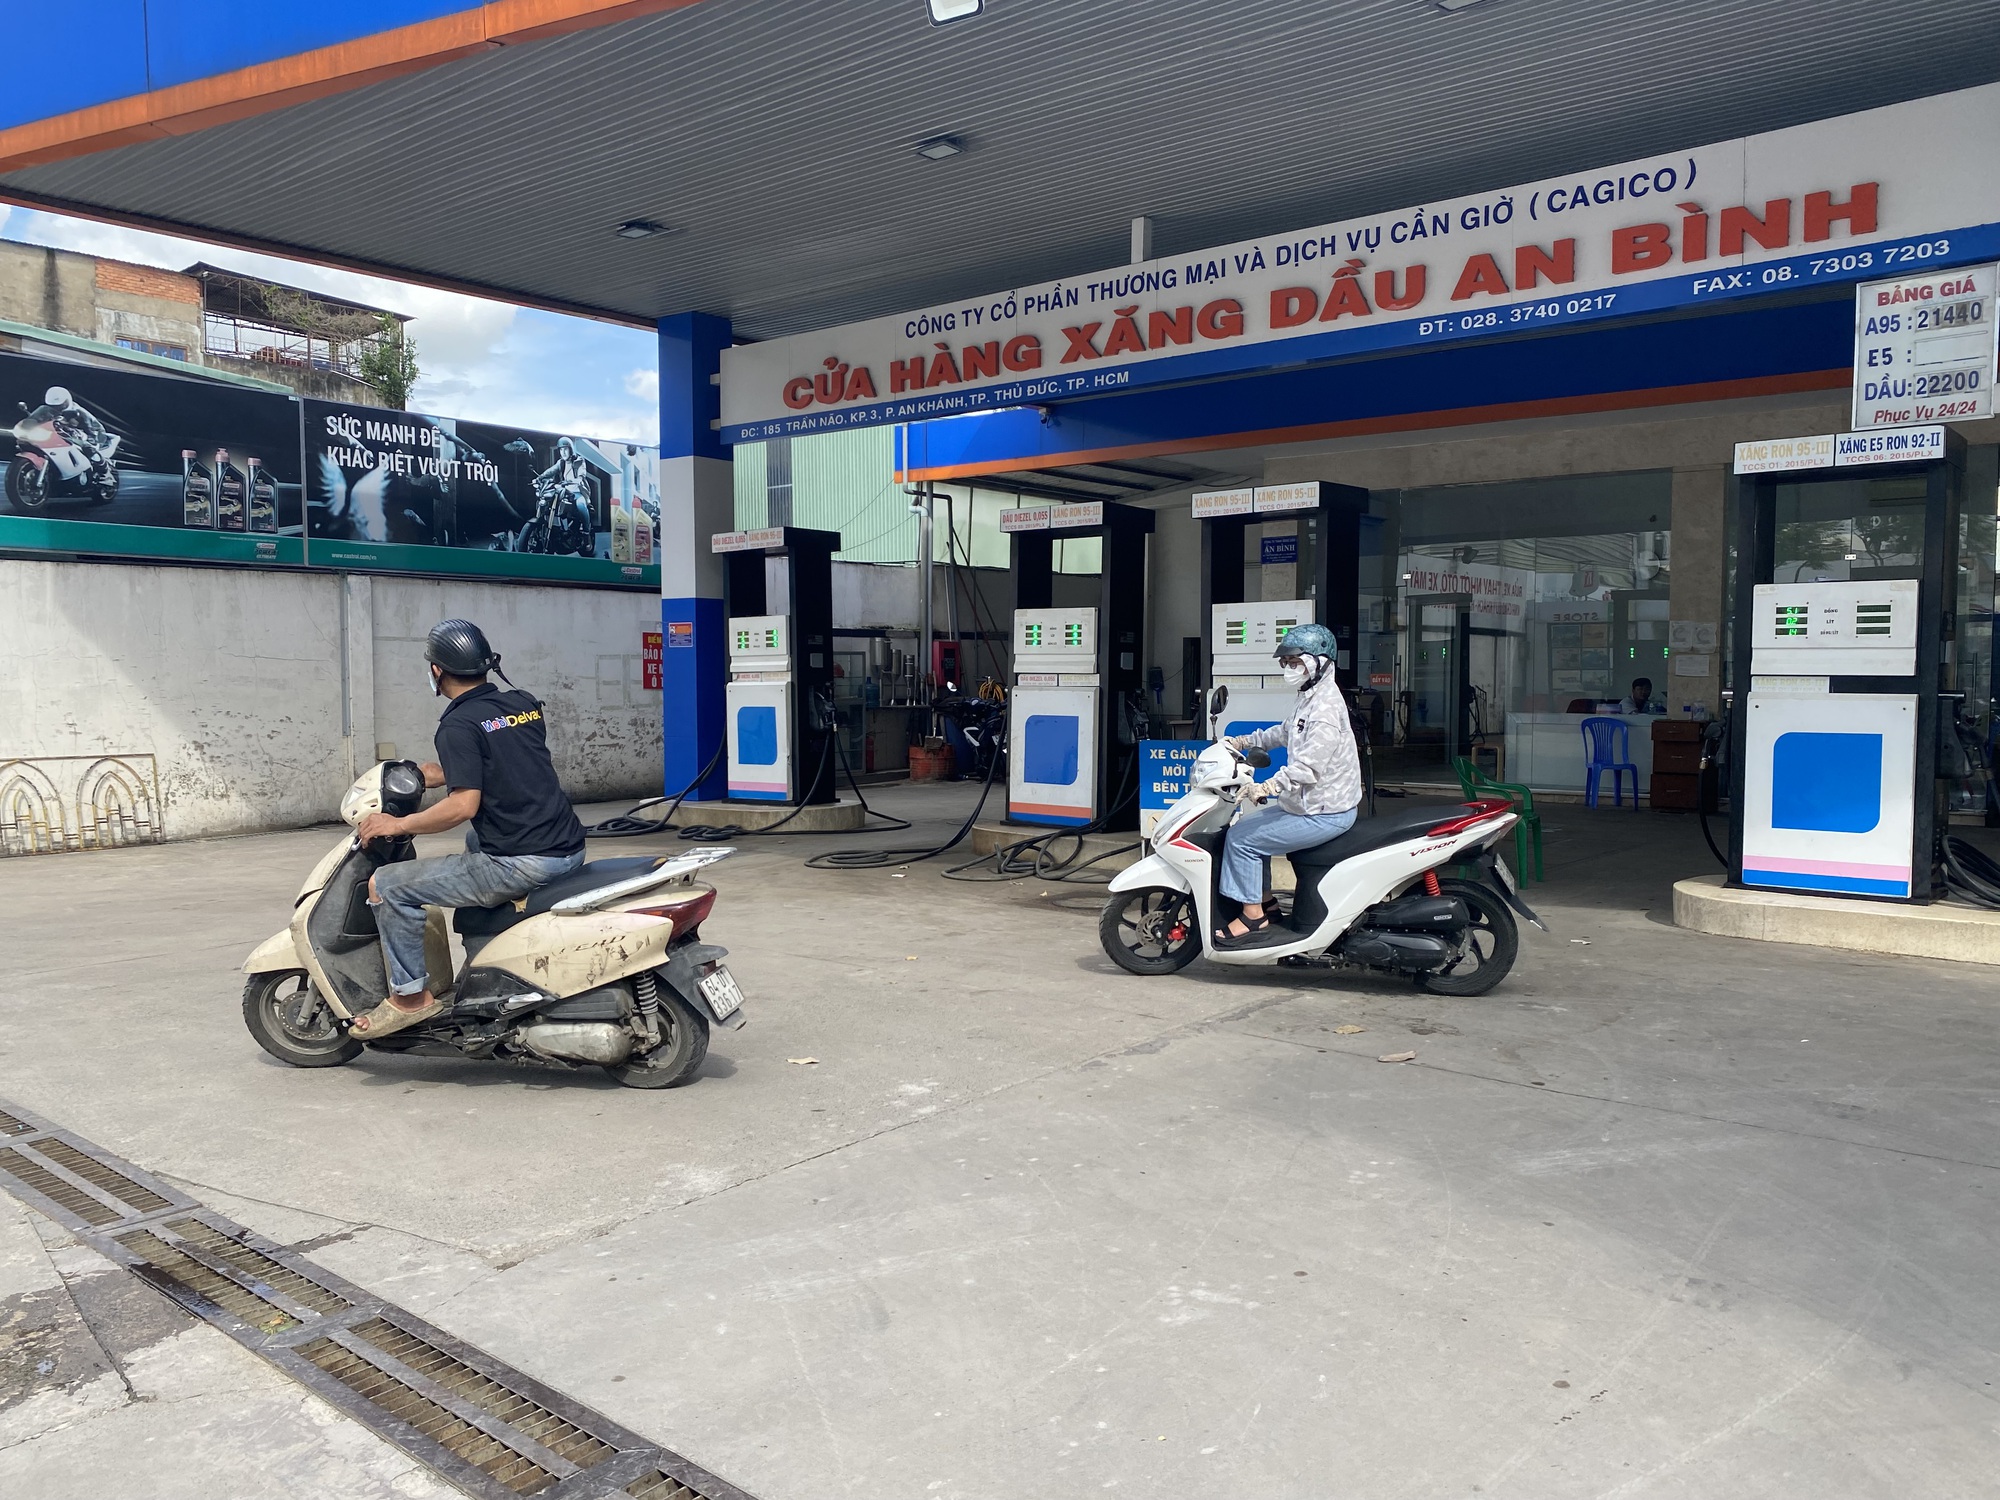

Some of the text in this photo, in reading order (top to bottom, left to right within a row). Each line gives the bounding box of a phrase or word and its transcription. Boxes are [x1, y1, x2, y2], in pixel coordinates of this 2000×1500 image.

[905, 313, 956, 339] CÔNG
[962, 306, 984, 327] TY
[990, 290, 1017, 322] CỔ
[1024, 283, 1079, 315] PHẦN
[1087, 268, 1177, 302] THƯƠNG
[1186, 258, 1226, 285] MẠI
[1234, 246, 1266, 274] VÀ
[1276, 235, 1336, 267] DỊCH
[1346, 226, 1381, 253] VỤ
[1390, 208, 1450, 244] CẦN
[1460, 196, 1514, 230] GIỜ
[1693, 239, 1951, 296] FAX: 08. 7303 7203
[782, 181, 1880, 410] CỬA HÀNG XĂNG DẦU AN BÌNH
[1877, 274, 1976, 306] BẢNG GIÁ
[1419, 293, 1618, 336] ĐT: 028. 3740 0217
[1917, 301, 1983, 329] 21440
[1916, 370, 1980, 396] 22200
[763, 424, 781, 435] 185
[786, 415, 816, 432] TRẦN
[994, 383, 1021, 401] THỦ
[1026, 380, 1062, 397] ĐỨC,
[1066, 377, 1090, 390] TP.
[1094, 371, 1129, 387] HCM
[1874, 400, 1977, 423] Phục Vụ 24/24
[326, 413, 362, 437] SỨC
[366, 421, 416, 446] MẠNH
[1771, 443, 1793, 458] RON
[1797, 440, 1830, 456] 95-III
[1839, 432, 1941, 454] XĂNG E5 RON 92-II
[327, 444, 499, 486] KHÁC BIỆT VƯỢT TRỘI
[1743, 462, 1766, 471] TCCS
[1785, 458, 1825, 468] 2015/PLX
[1845, 454, 1870, 463] TCCS
[1890, 450, 1933, 460] 2015/PLX
[1214, 495, 1228, 507] RON
[1278, 489, 1293, 501] RON
[1294, 487, 1316, 499] 95-III
[1069, 506, 1082, 517] RON
[643, 645, 659, 660] BẢO
[647, 663, 657, 674] XE
[1149, 749, 1166, 759] XE
[1170, 745, 1197, 759] GẮN
[1162, 763, 1186, 776] MỜI
[1153, 780, 1179, 793] BÊN
[1409, 839, 1458, 857] VISION
